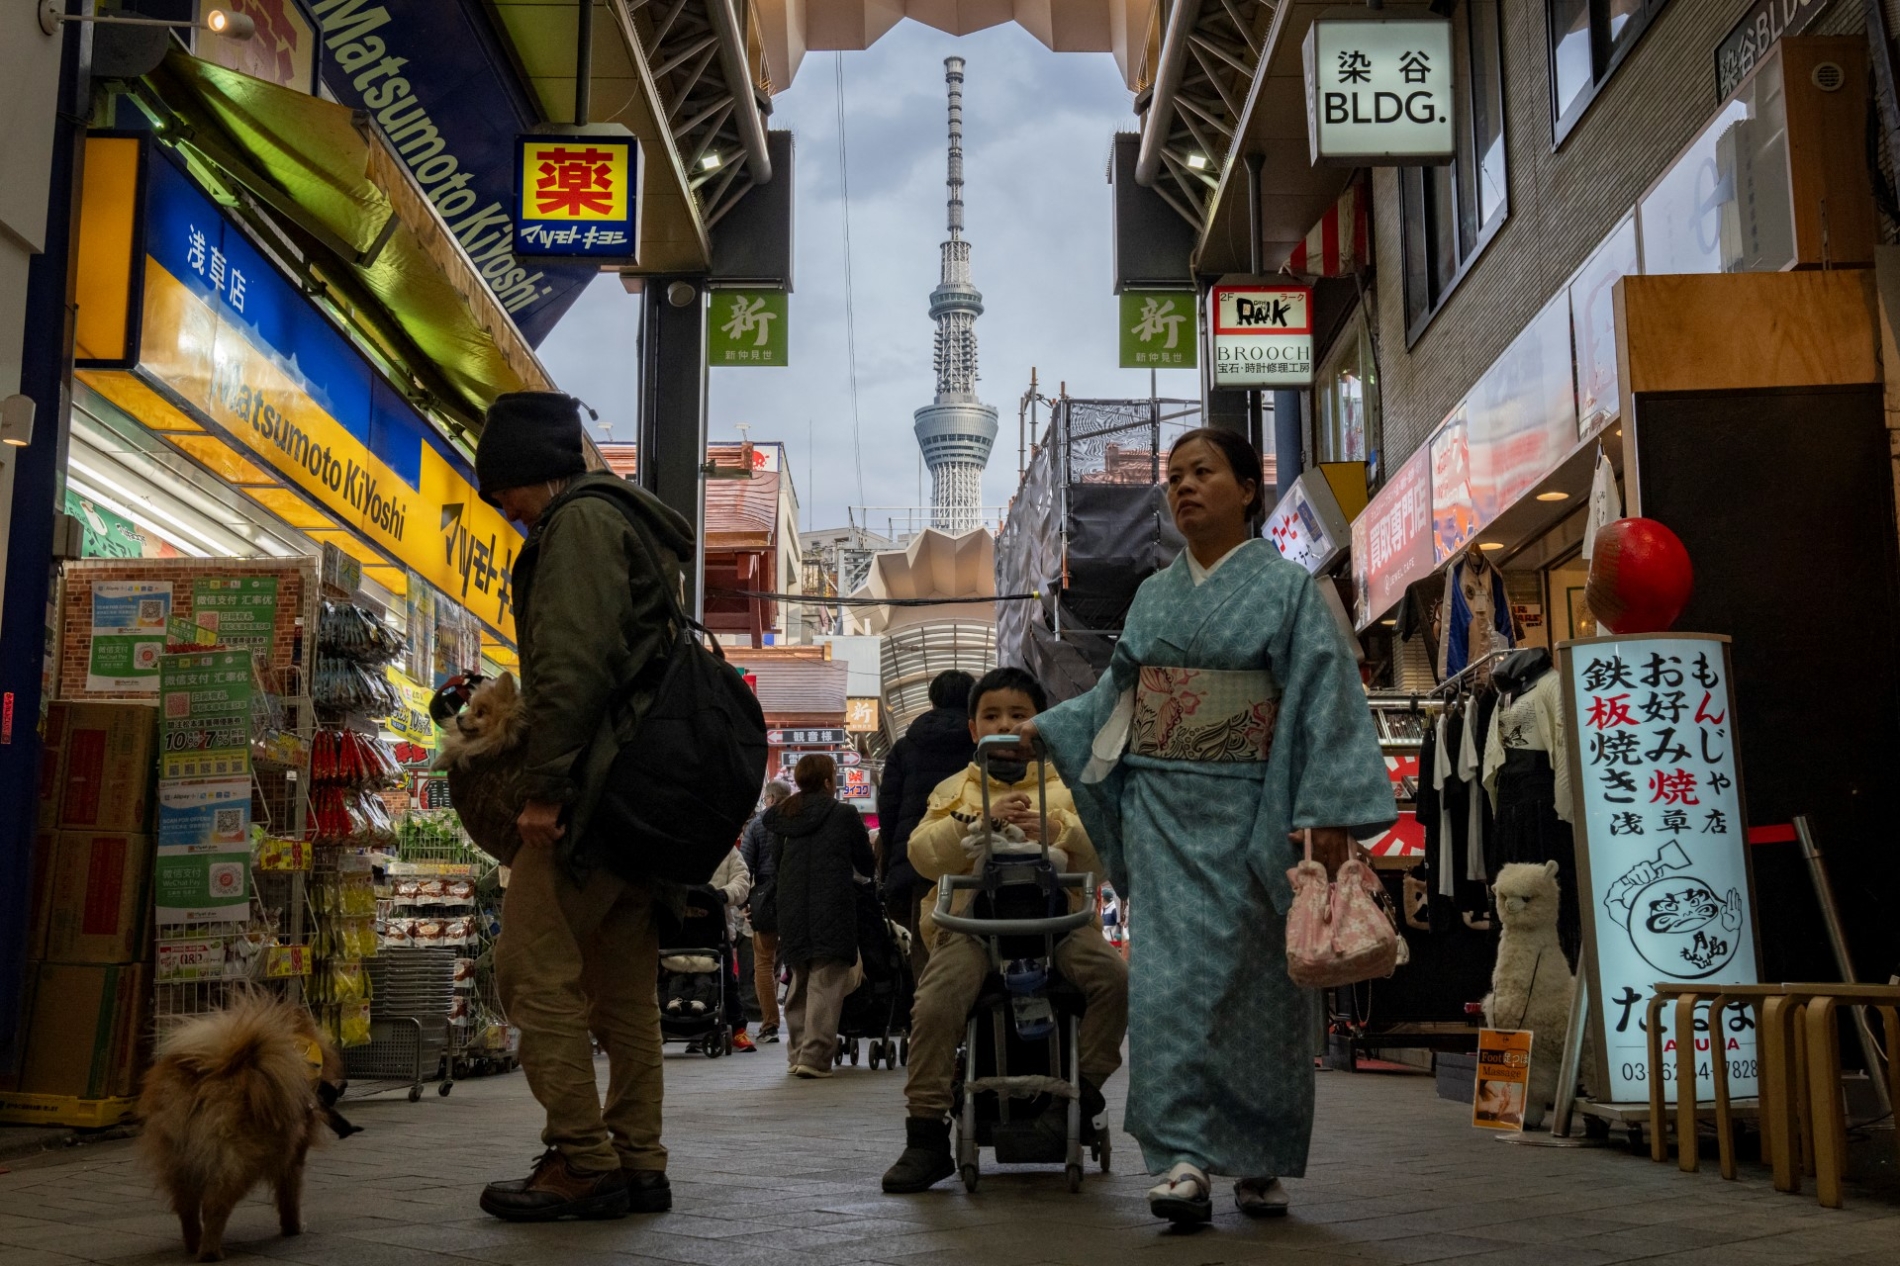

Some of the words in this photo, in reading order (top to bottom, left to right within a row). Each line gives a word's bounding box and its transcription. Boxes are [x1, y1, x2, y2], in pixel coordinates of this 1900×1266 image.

[1720, 0, 1812, 101] 染谷BLD
[1338, 50, 1431, 84] 染谷
[312, 0, 477, 217] Matsumoto
[1325, 91, 1446, 124] BLDG.
[536, 147, 614, 216] 薬
[521, 224, 628, 249] マツモトキヨシ
[187, 224, 246, 313] 浅草店
[1220, 292, 1234, 301] 2F
[1280, 293, 1304, 302] ラーク
[721, 295, 777, 346] 新
[1131, 297, 1186, 349] 新
[725, 350, 772, 360] 新仲見世
[1136, 352, 1182, 363] 新仲見世
[1218, 346, 1310, 361] BROOCH
[440, 502, 514, 625] マツモトキ
[851, 702, 873, 724] 新
[1691, 652, 1732, 796] もんじゃ
[793, 731, 832, 742] 観音様
[1581, 655, 1643, 804] 鉄板焼き
[1637, 652, 1700, 806] お好み焼
[1609, 808, 1728, 836] 浅草店
[1481, 1052, 1502, 1063] Foot
[1663, 1038, 1740, 1052] AUA
[1482, 1066, 1521, 1080] Massage
[1622, 1059, 1758, 1081] 03-64-828
